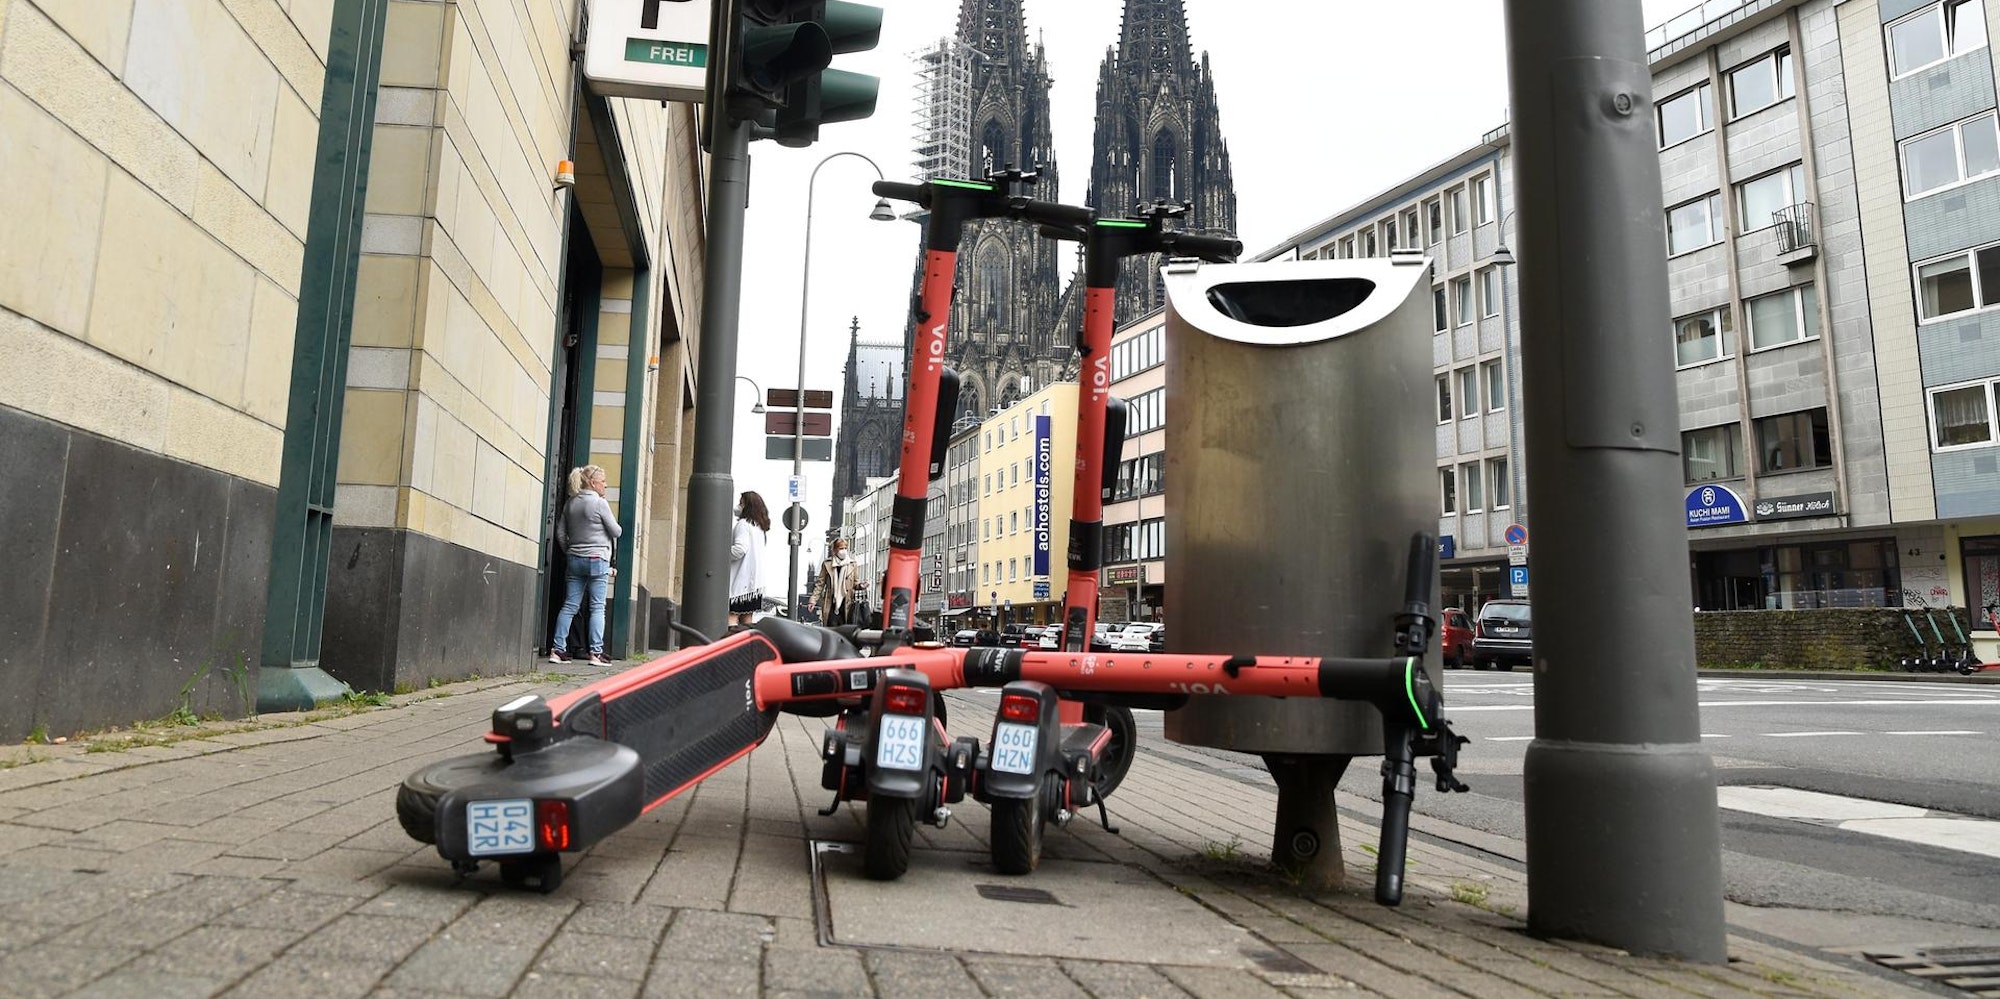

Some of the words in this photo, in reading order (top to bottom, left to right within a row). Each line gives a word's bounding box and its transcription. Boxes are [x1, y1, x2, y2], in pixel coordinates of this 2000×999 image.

[650, 46, 694, 63] FREI
[927, 324, 945, 372] voi.
[1092, 355, 1110, 402] voi.
[1036, 437, 1050, 551] aohostels.com
[1689, 508, 1710, 518] KUCHI
[1711, 506, 1730, 515] MAMI
[1908, 548, 1921, 556] 43
[934, 553, 942, 585] Thai
[1514, 570, 1524, 582] P
[994, 647, 1007, 672] DEVK
[886, 720, 918, 741] 666
[1001, 729, 1032, 749] 660
[883, 743, 918, 765] HZS
[997, 748, 1031, 769] HZN
[473, 806, 500, 849] HZR
[503, 806, 528, 846] 042
